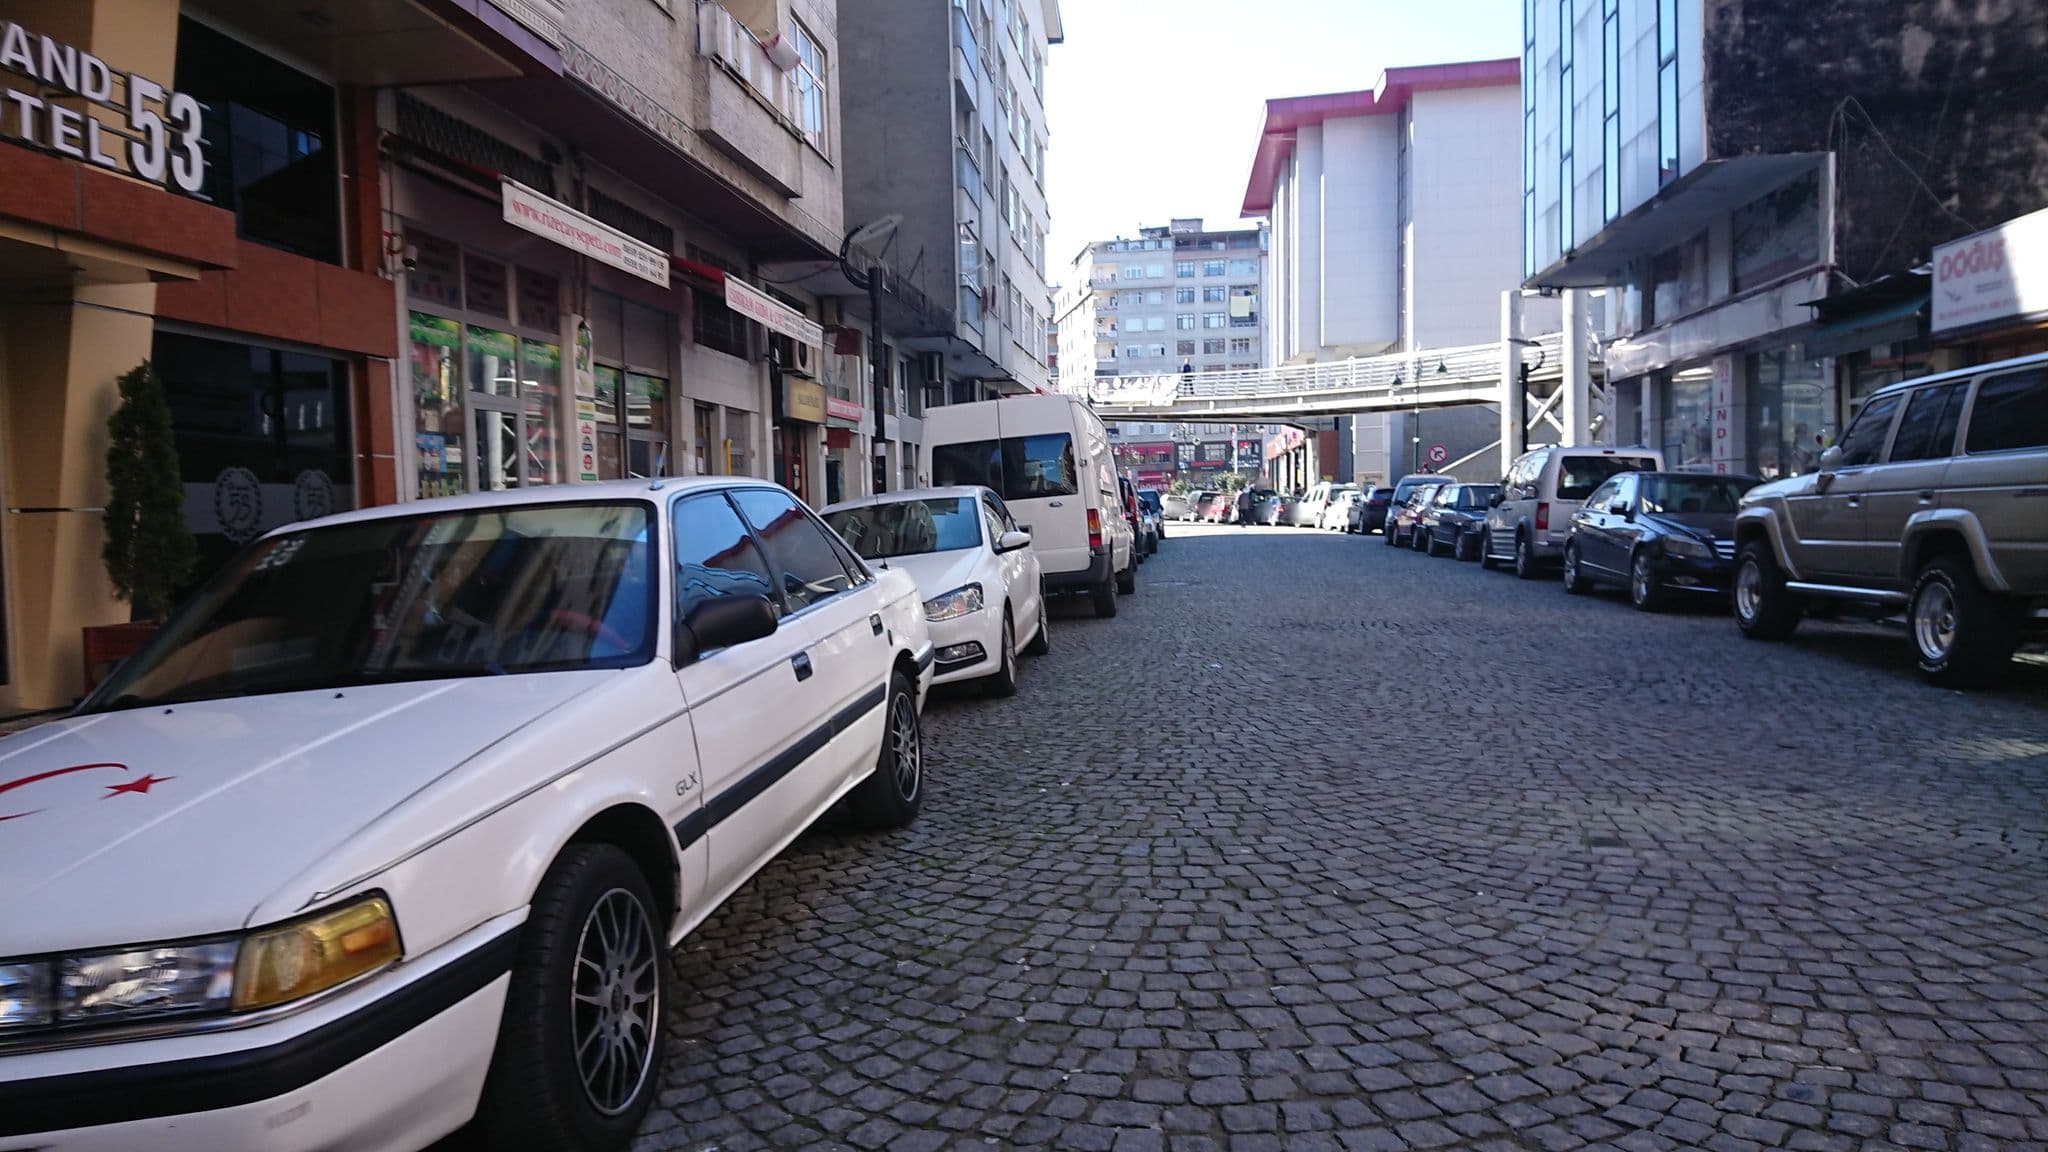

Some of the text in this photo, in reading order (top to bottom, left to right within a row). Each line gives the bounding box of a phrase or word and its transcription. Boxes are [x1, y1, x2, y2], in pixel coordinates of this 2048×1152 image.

[0, 88, 117, 168] TEL
[129, 72, 205, 193] 53
[675, 771, 699, 796] GLX
